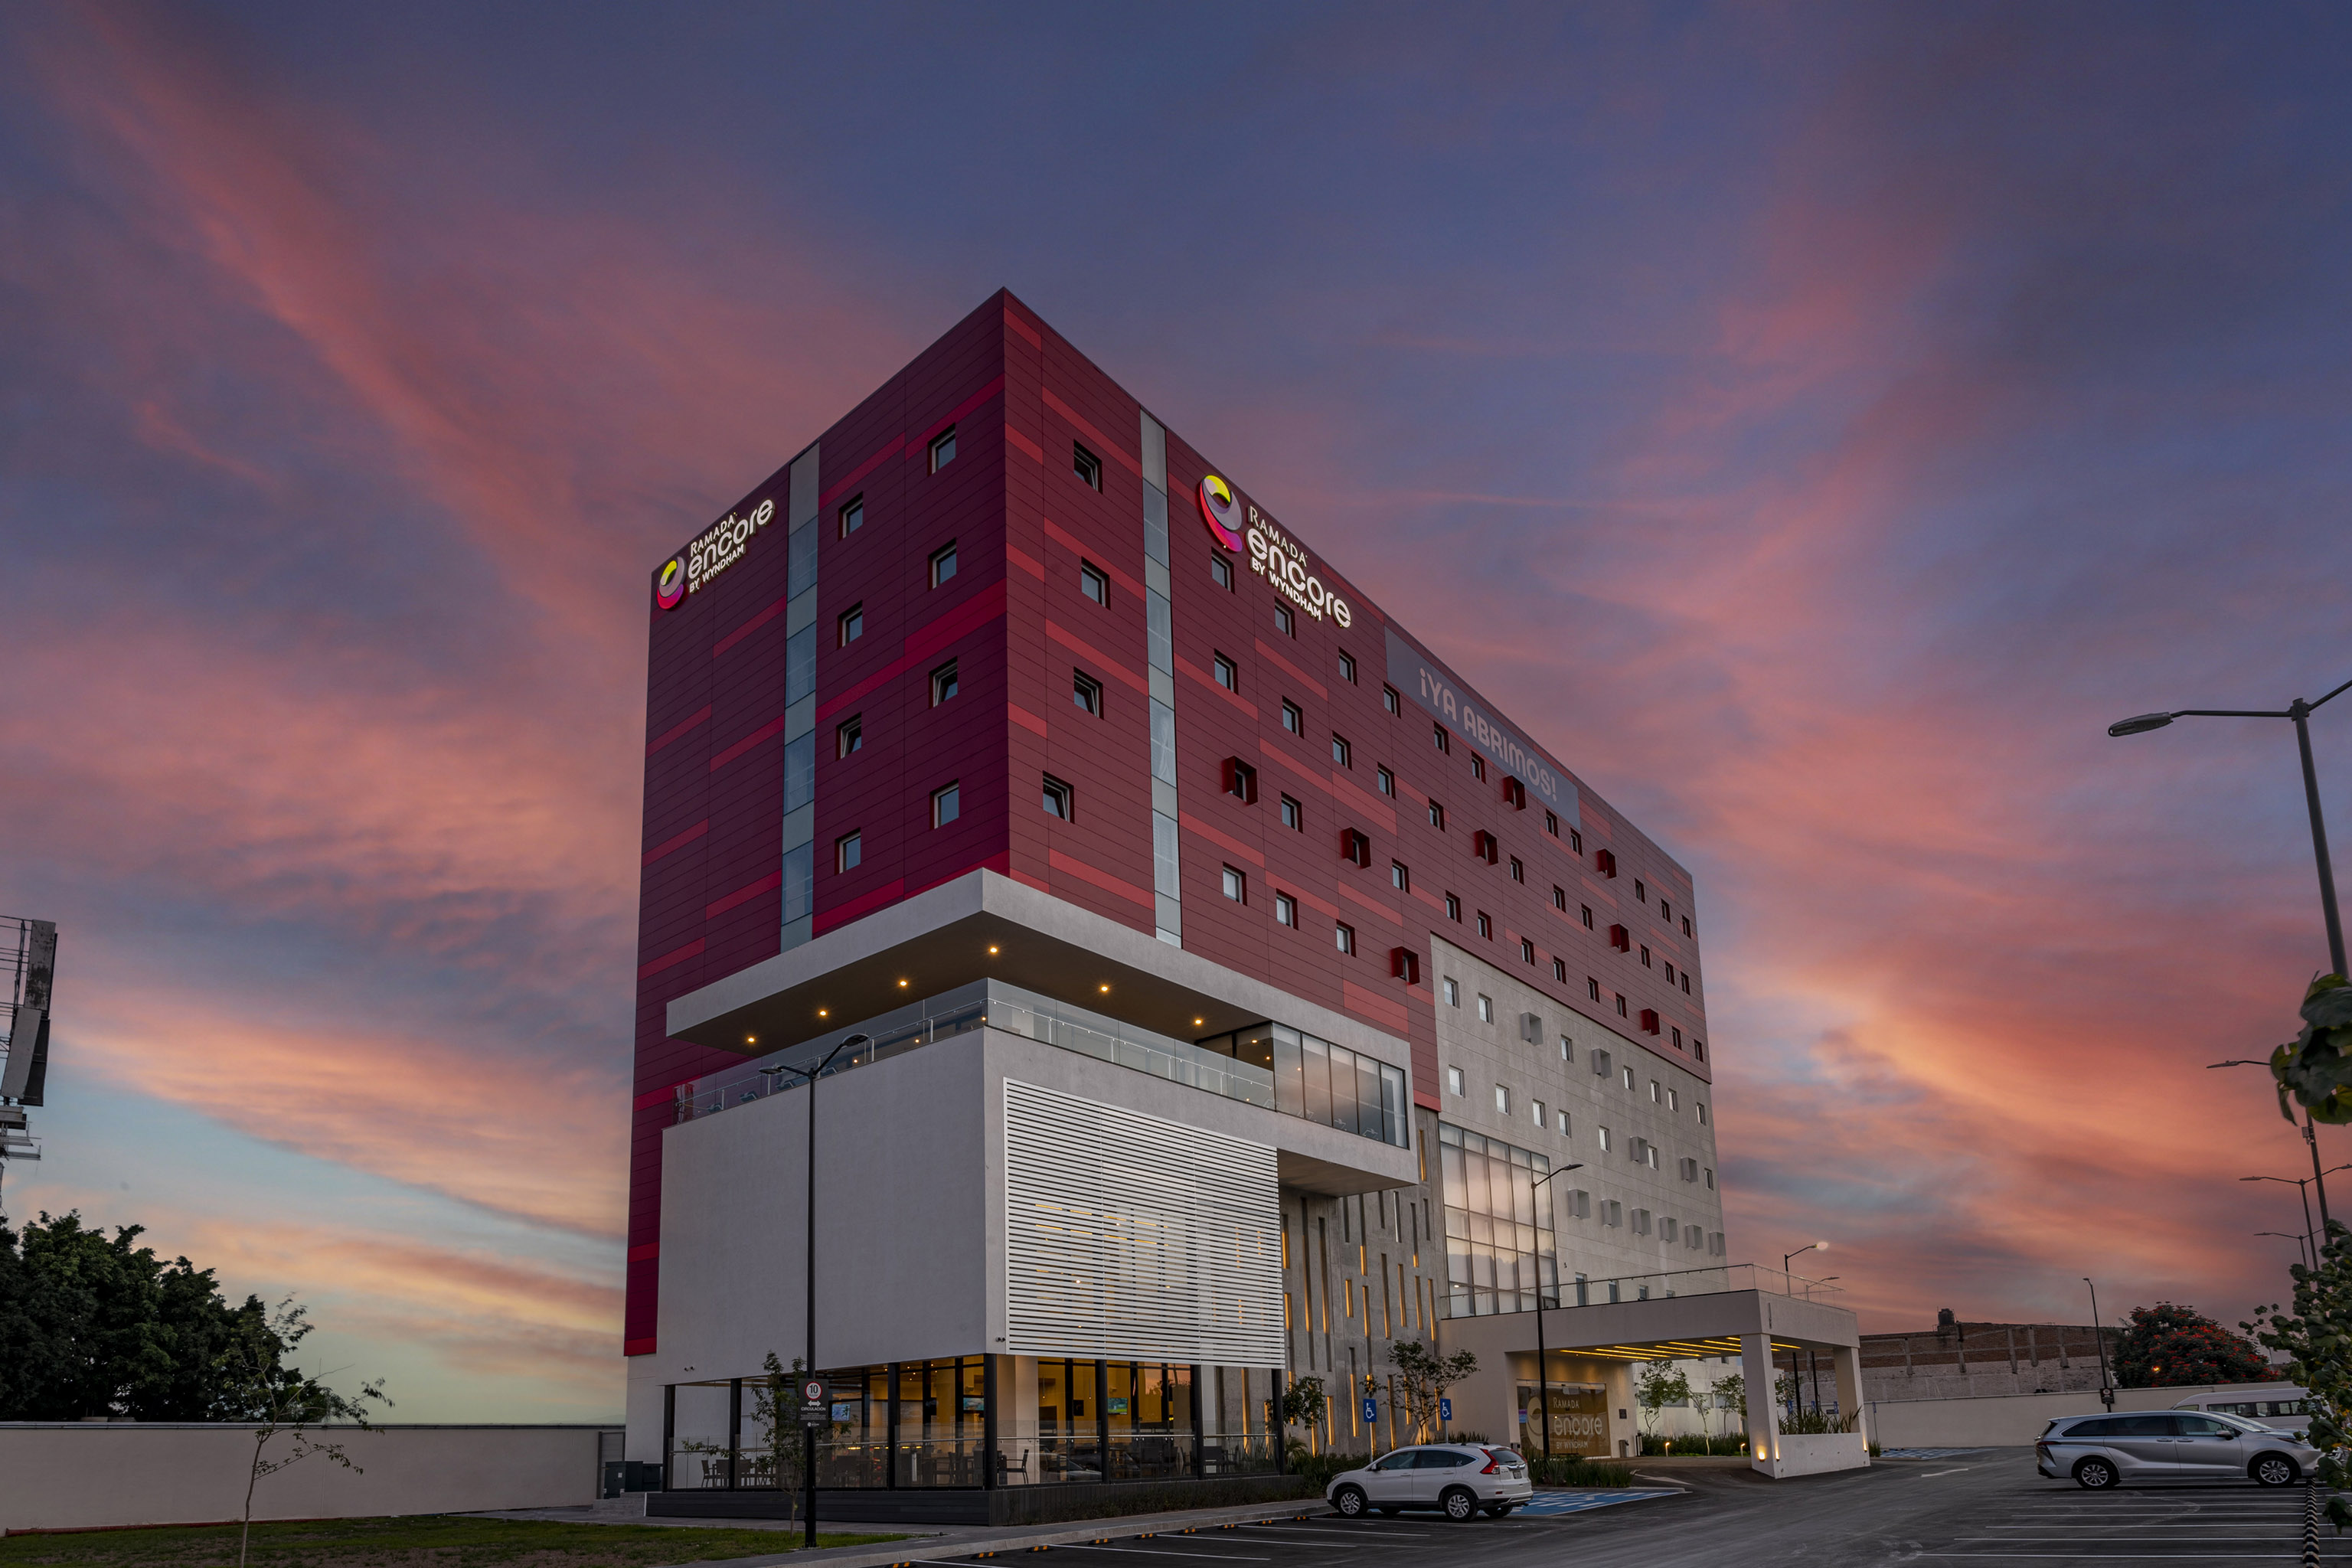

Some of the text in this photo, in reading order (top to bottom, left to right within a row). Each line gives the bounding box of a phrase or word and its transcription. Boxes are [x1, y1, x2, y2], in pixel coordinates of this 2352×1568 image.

[688, 499, 775, 580] encore
[691, 514, 736, 557] RAMADA
[1249, 505, 1307, 567] RAMADA
[690, 544, 746, 593] BY WYNDHAM
[1246, 528, 1351, 628] encore
[1251, 557, 1321, 621] BY WYNDHAM
[1419, 668, 1557, 802] ¡YA ABRIMOS!
[809, 1385, 818, 1393] 10
[1554, 1418, 1602, 1436] encore
